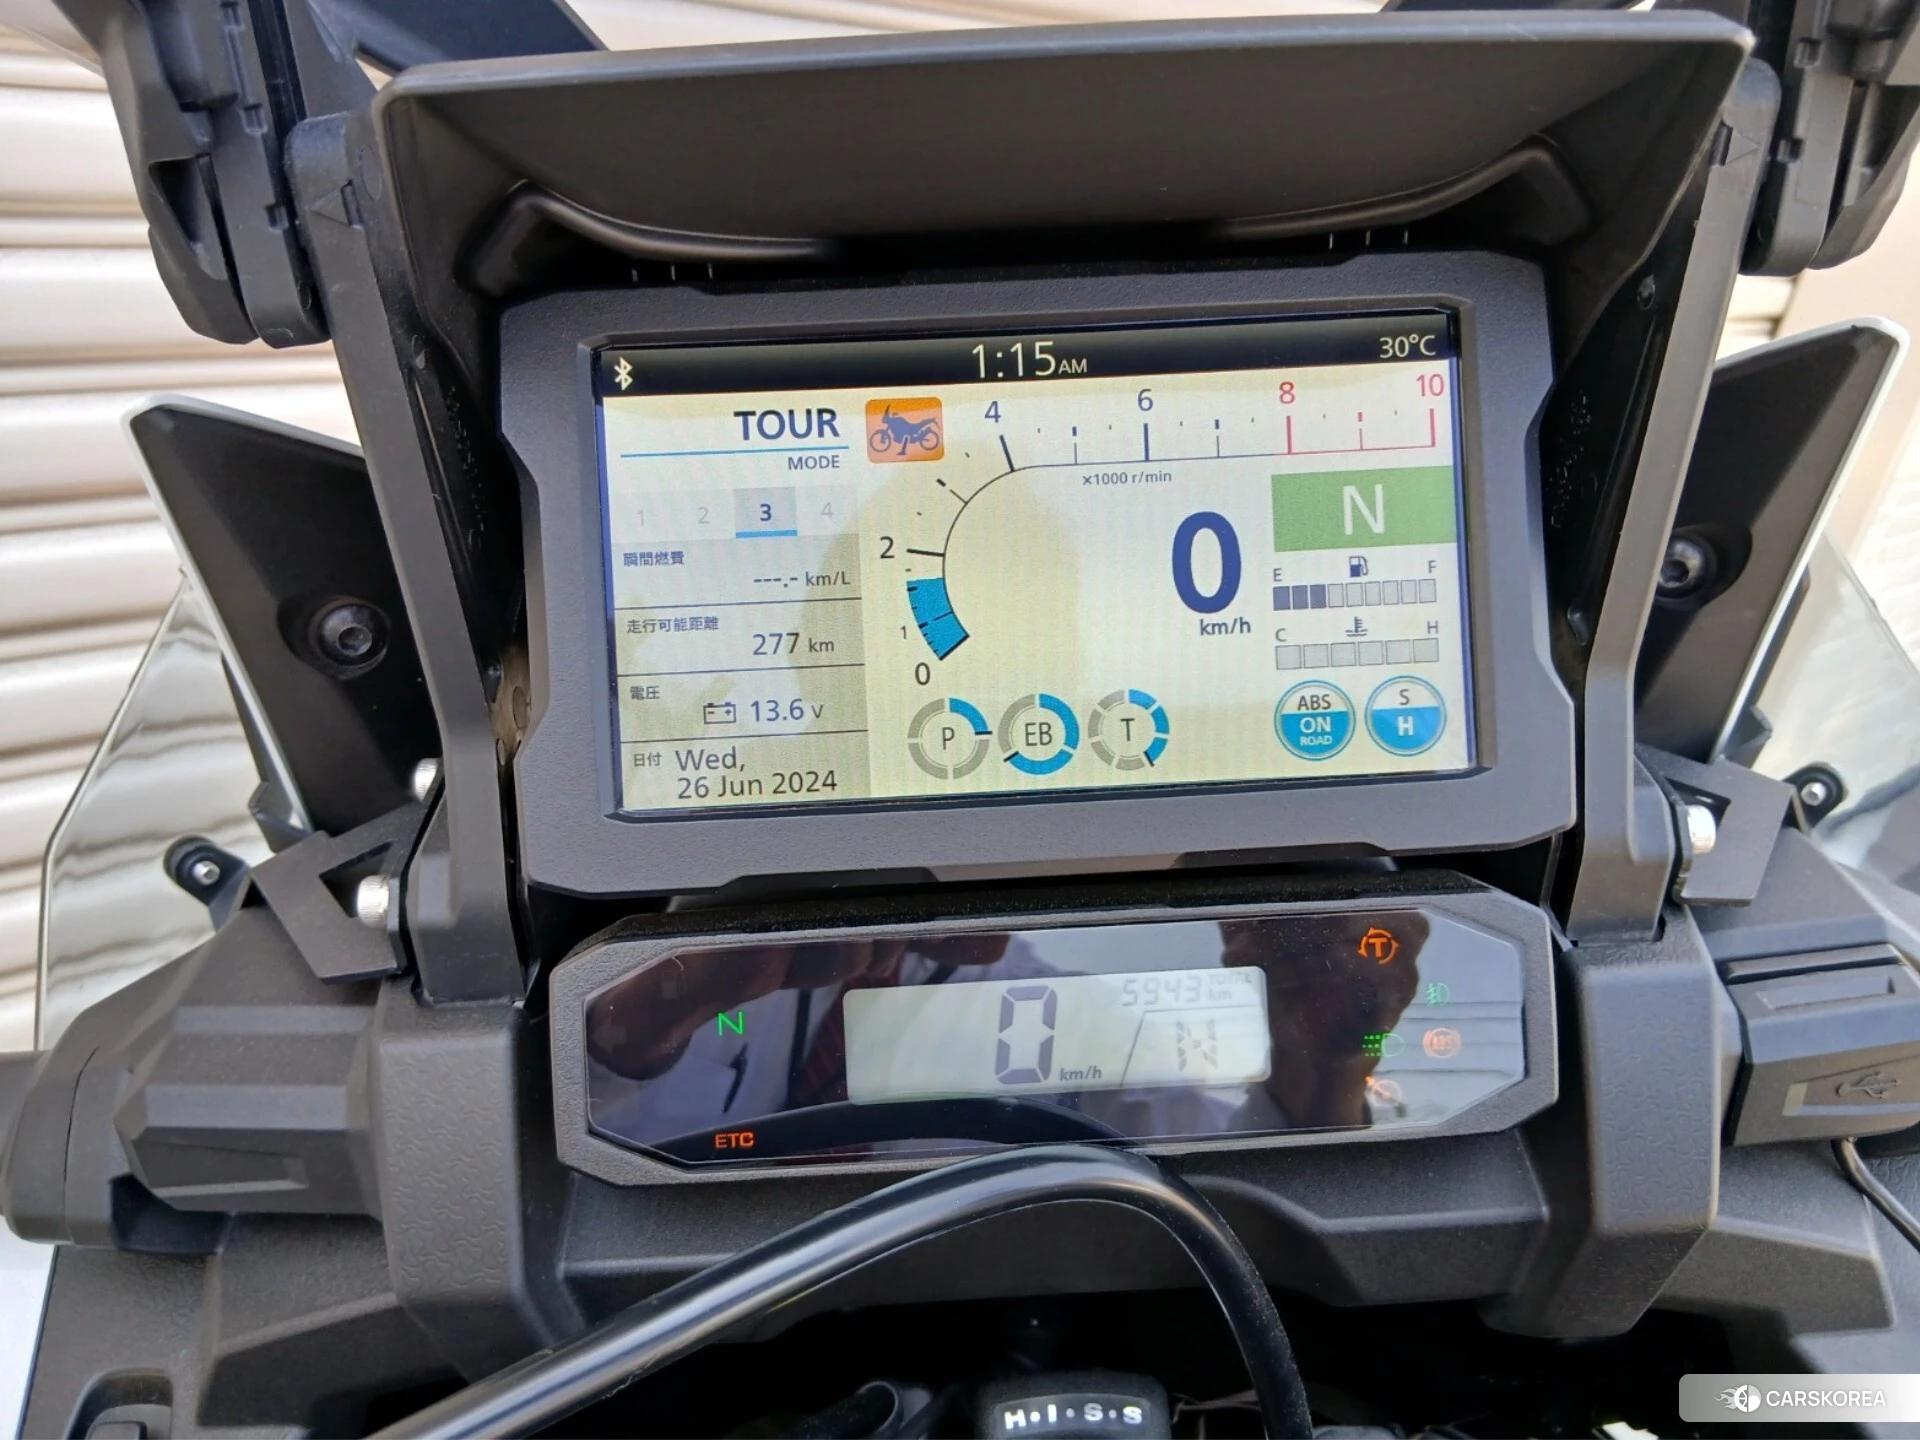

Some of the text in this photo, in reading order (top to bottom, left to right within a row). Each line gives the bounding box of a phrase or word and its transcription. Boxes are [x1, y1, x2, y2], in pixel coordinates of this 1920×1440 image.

[1379, 333, 1437, 359] 30°C
[1279, 381, 1296, 404] 8
[1416, 373, 1445, 397] 10
[1137, 388, 1154, 412] 6
[984, 400, 1002, 423] 4
[733, 407, 841, 442] TOUR
[788, 454, 841, 471] MODE
[1132, 469, 1172, 484] r/min
[697, 506, 710, 525] 2
[758, 503, 773, 522] 3
[819, 501, 834, 519] 4
[1341, 483, 1386, 536] N
[879, 536, 895, 559] 2
[622, 550, 685, 567] 瞬間燃費
[1171, 510, 1243, 614] 0
[1427, 560, 1437, 574] F
[804, 570, 852, 587] km/L
[1272, 568, 1283, 582] E
[626, 615, 720, 634] 走行可能距離
[900, 625, 908, 640] 1
[1199, 616, 1252, 636] km/h
[1426, 620, 1439, 635] H
[752, 631, 835, 656] 277 km
[1275, 628, 1287, 642] C
[914, 661, 931, 686] 0
[629, 684, 661, 701] 電圧
[1297, 693, 1332, 712] ABS
[1399, 688, 1410, 706] S
[749, 698, 805, 723] 13.6
[1024, 721, 1053, 747] EB
[1120, 717, 1136, 742] T
[1300, 716, 1332, 733] ON
[1397, 714, 1414, 737] H
[941, 726, 955, 751] P
[1300, 733, 1333, 746] ROAD
[633, 751, 662, 768] 日付
[675, 746, 746, 772] Wed,
[677, 769, 838, 800] 26 Jun 2024
[1121, 974, 1203, 1007] 5943
[717, 1010, 744, 1037] N
[994, 984, 1058, 1085] 0
[1060, 1065, 1103, 1082] km/h
[714, 1131, 755, 1150] ETC
